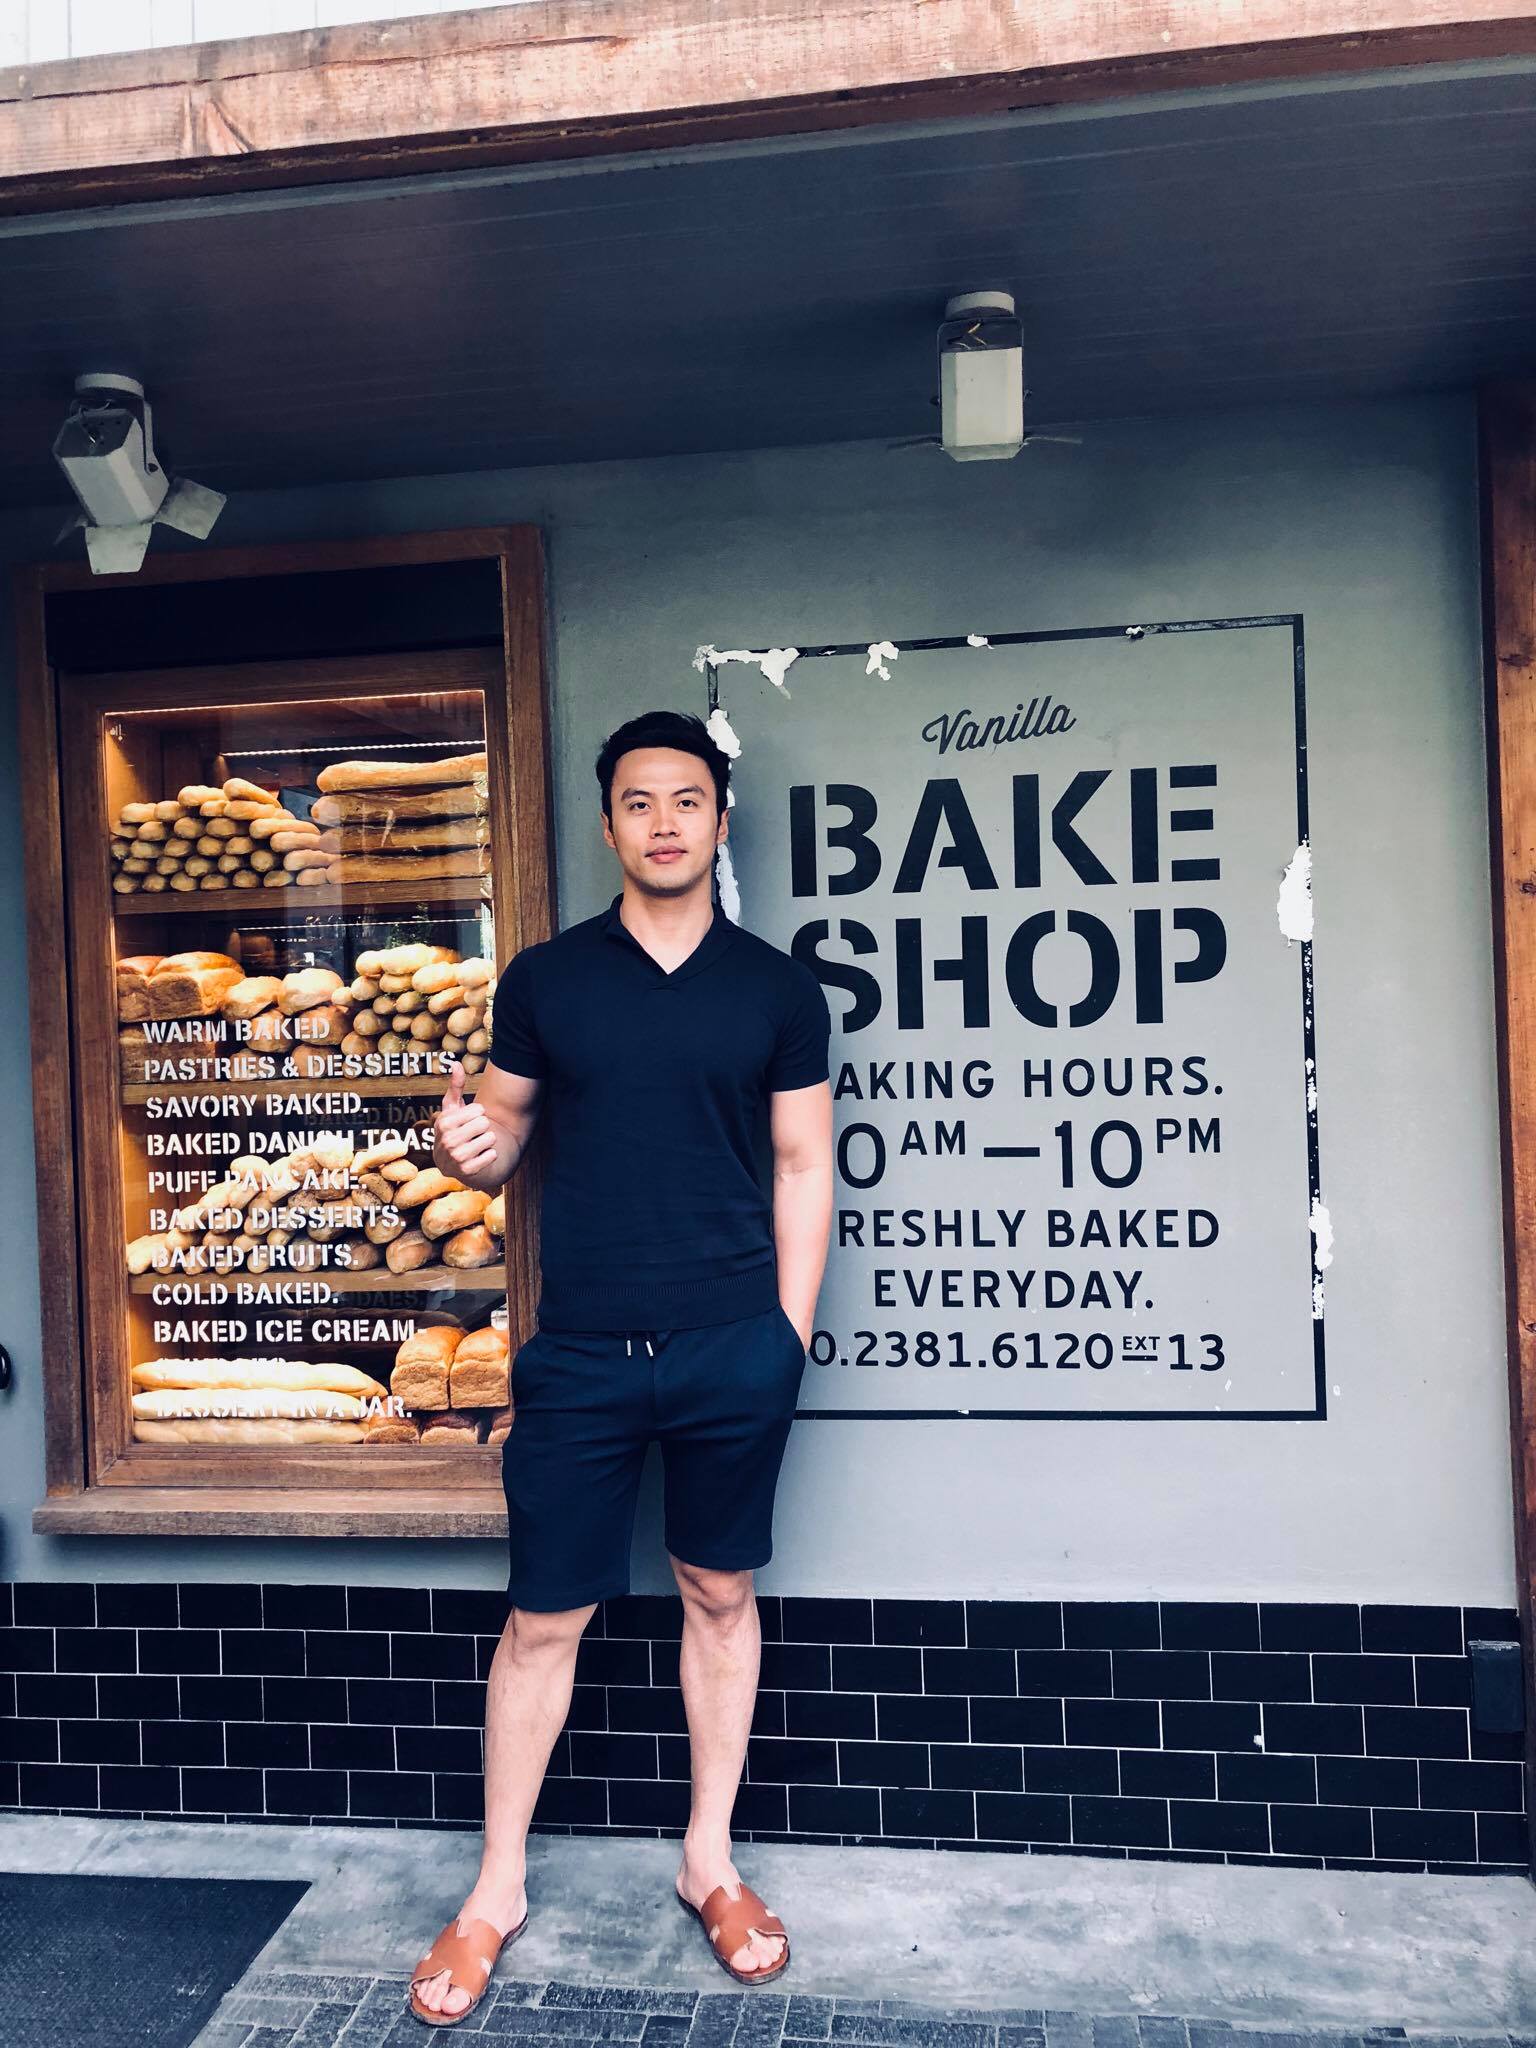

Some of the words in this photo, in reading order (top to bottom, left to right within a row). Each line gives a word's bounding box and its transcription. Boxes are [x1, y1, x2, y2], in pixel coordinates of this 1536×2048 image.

[921, 695, 1077, 755] Vanilla
[789, 764, 1221, 898] BAKE
[790, 907, 1228, 1035] SHOP
[142, 1020, 226, 1044] WARM
[235, 1017, 331, 1042] BAKED
[144, 1056, 276, 1081] PASTRIES
[281, 1056, 299, 1078] &
[307, 1051, 456, 1077] DESSERTS
[833, 1060, 994, 1100] AKING
[1024, 1056, 1224, 1098] HOURS.
[146, 1094, 258, 1119] SAVORY
[266, 1092, 369, 1116] BAKED.
[147, 1132, 241, 1156] BAKED
[249, 1130, 354, 1154] DANIH
[361, 1127, 436, 1152] TOAS
[148, 1170, 217, 1193] PUFF
[150, 1207, 243, 1231] BAKED
[252, 1204, 406, 1229] DESSERTS.
[839, 1209, 1026, 1248] RESHLY
[1047, 1209, 1220, 1248] BAKED
[151, 1245, 244, 1268] BAKED
[252, 1243, 359, 1266] FRUITS.
[152, 1283, 228, 1306] COLD
[236, 1281, 338, 1305] BAKED.
[874, 1269, 1153, 1309] EVERYDAY.
[153, 1320, 247, 1343] BAKED
[256, 1319, 302, 1343] ICE
[809, 1330, 1113, 1370] 0.2381.6120
[1122, 1335, 1160, 1351] EXT
[1168, 1333, 1225, 1371] 13
